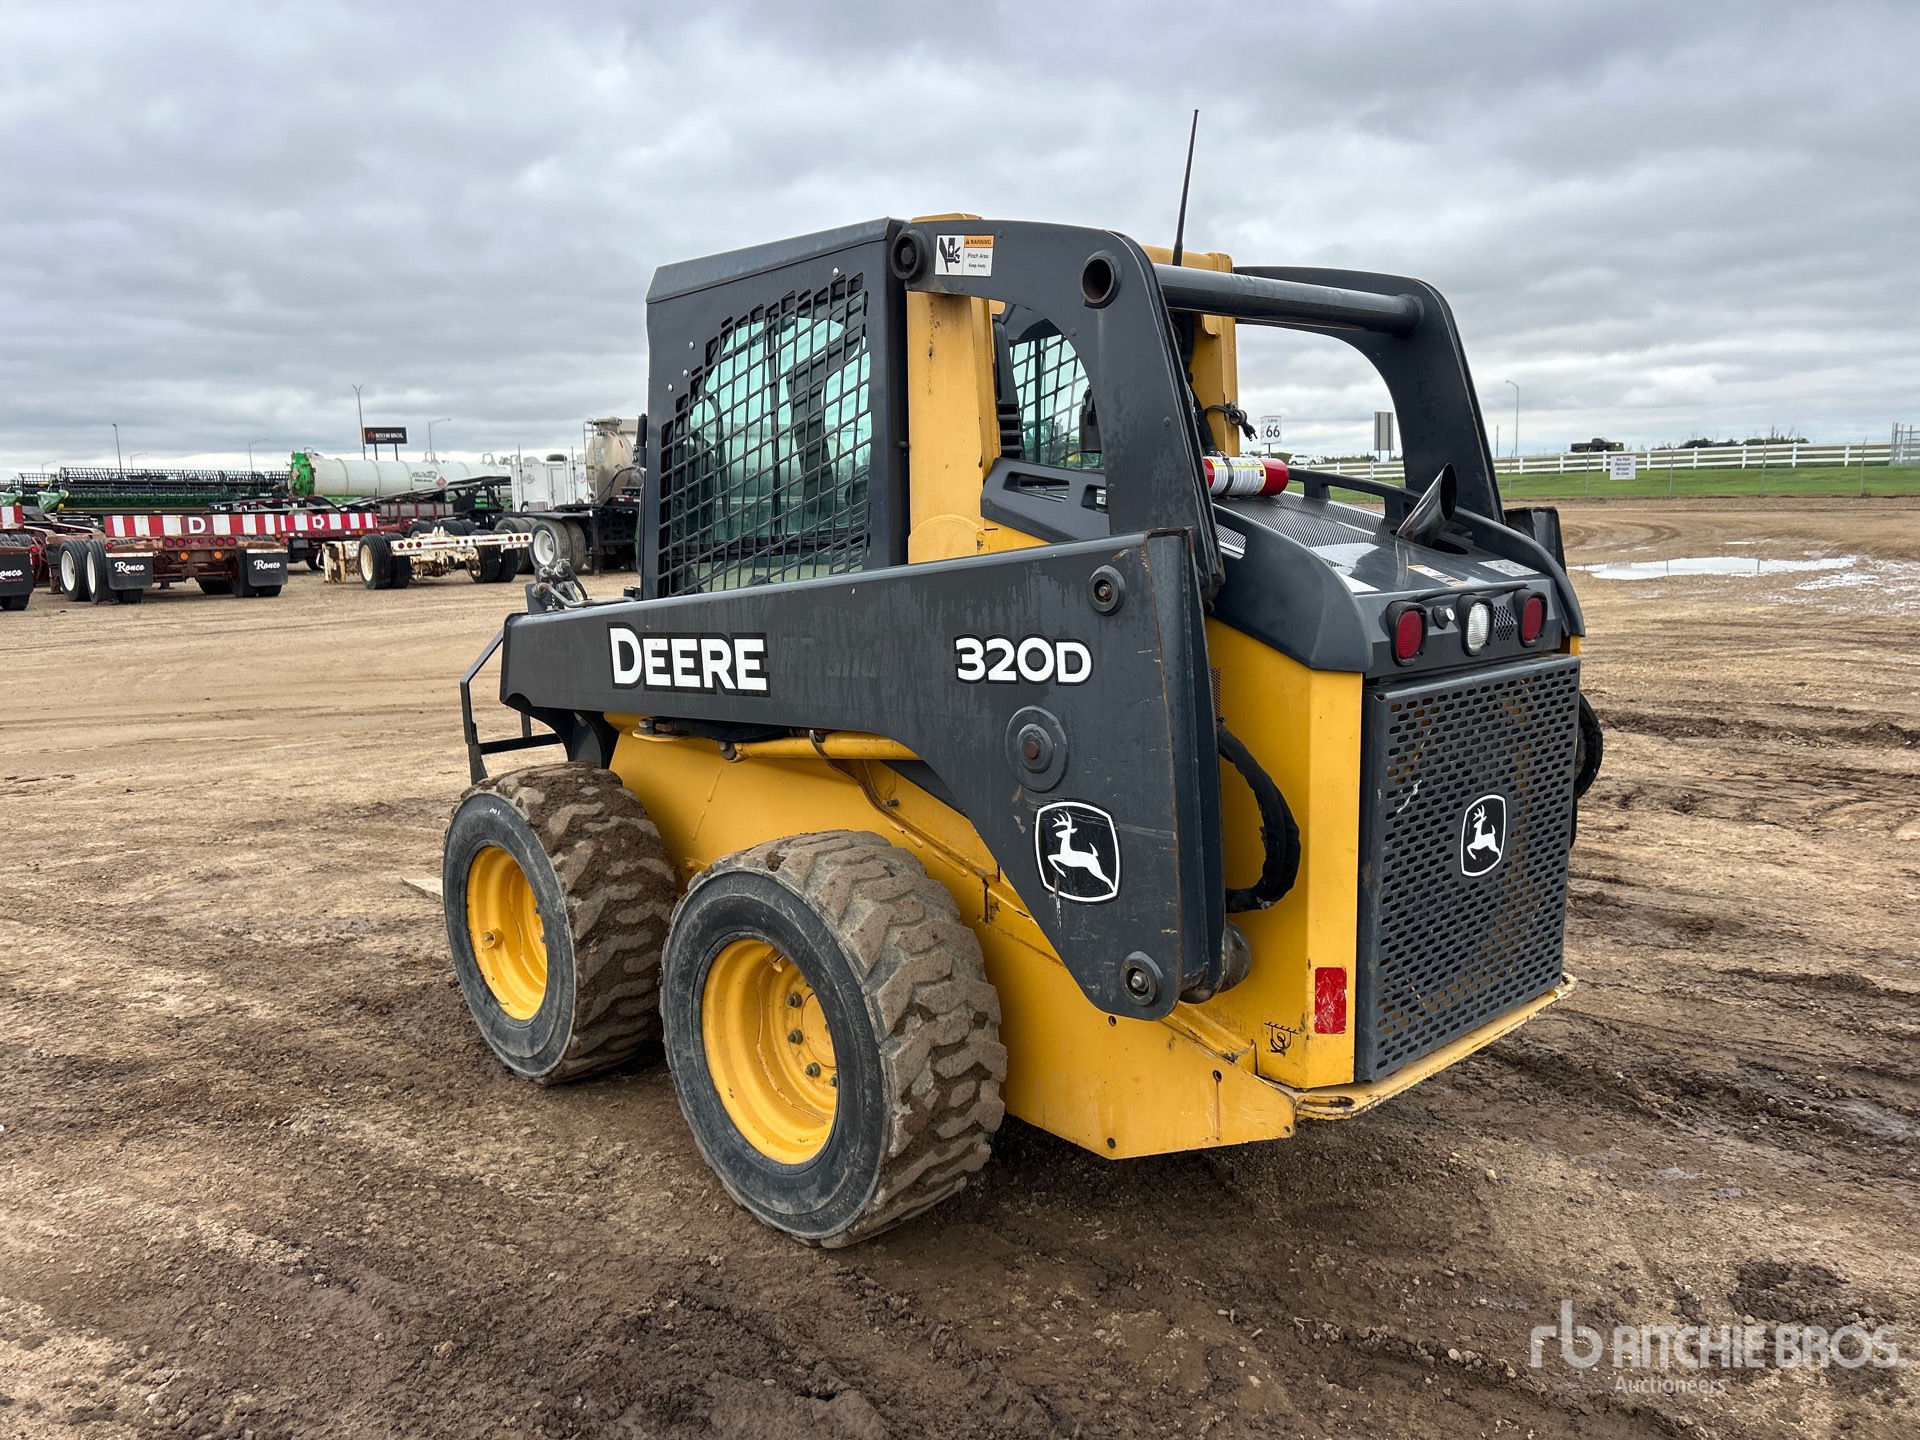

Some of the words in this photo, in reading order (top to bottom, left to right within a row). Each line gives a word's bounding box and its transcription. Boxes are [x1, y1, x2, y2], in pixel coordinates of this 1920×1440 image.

[1266, 425, 1280, 438] 66
[188, 516, 206, 534] D
[114, 561, 145, 574] Ronco
[254, 559, 281, 570] Ronco
[609, 627, 768, 691] DEERE
[955, 637, 1092, 683] 320D
